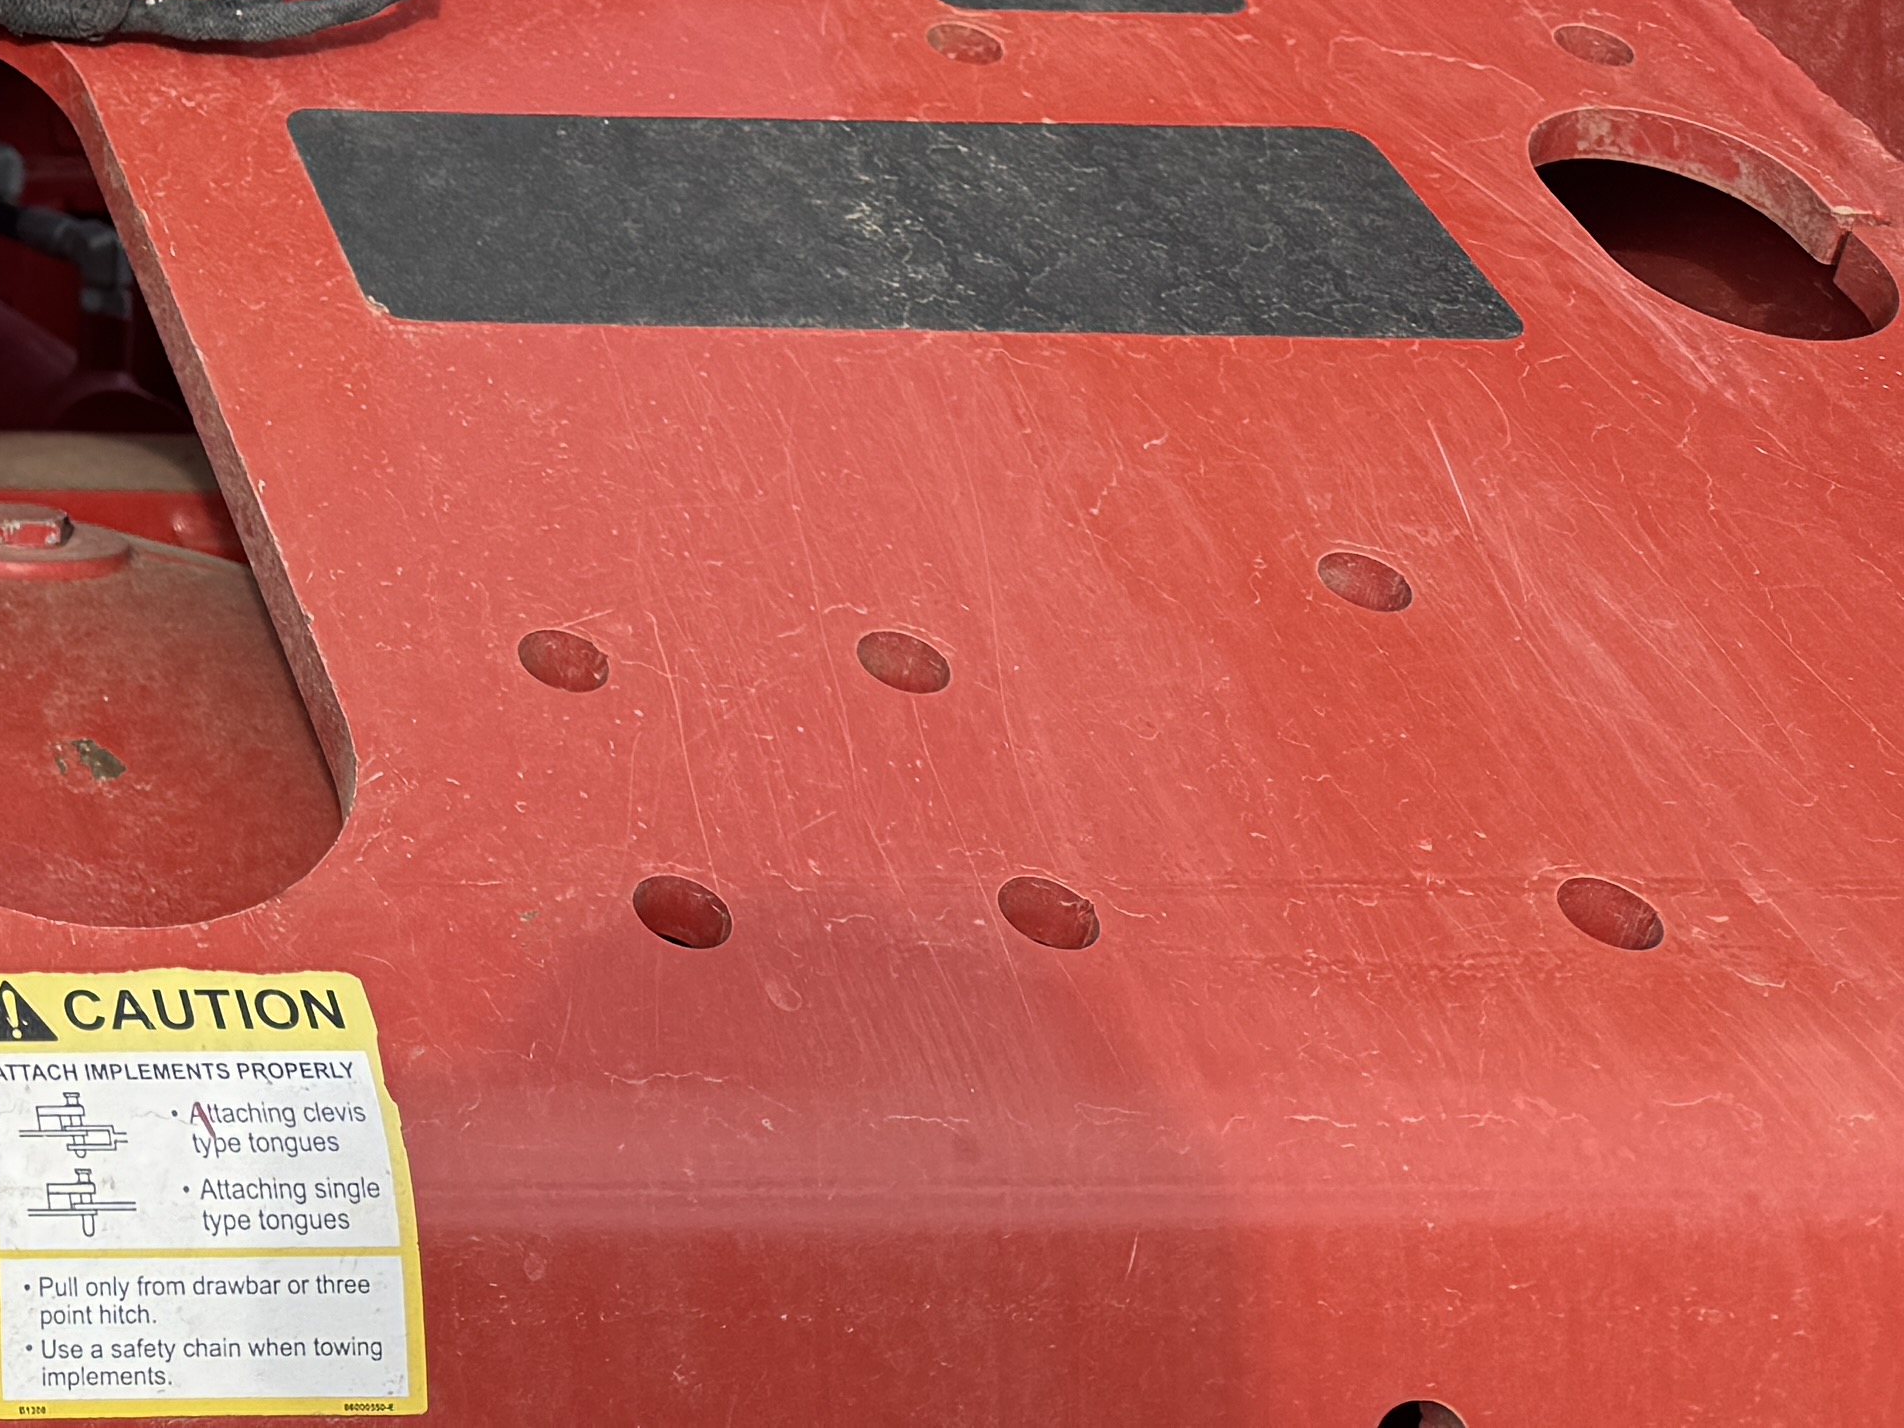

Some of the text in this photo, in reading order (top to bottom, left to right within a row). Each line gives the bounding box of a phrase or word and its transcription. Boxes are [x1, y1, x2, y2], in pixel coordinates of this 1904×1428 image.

[63, 988, 347, 1031] CAUTION
[84, 1062, 231, 1081] IMPLEMENTS
[237, 1061, 354, 1081] PROPERLY
[190, 1100, 367, 1129] Attaching clevis
[191, 1131, 341, 1159] type tongues
[200, 1177, 381, 1206] Attaching single
[202, 1208, 351, 1236] type tongues
[38, 1275, 371, 1301] Pull only from drawbar or three
[39, 1303, 157, 1330] point hitch.
[40, 1336, 383, 1363] Use a safety chain when towing
[40, 1366, 173, 1391] implements.
